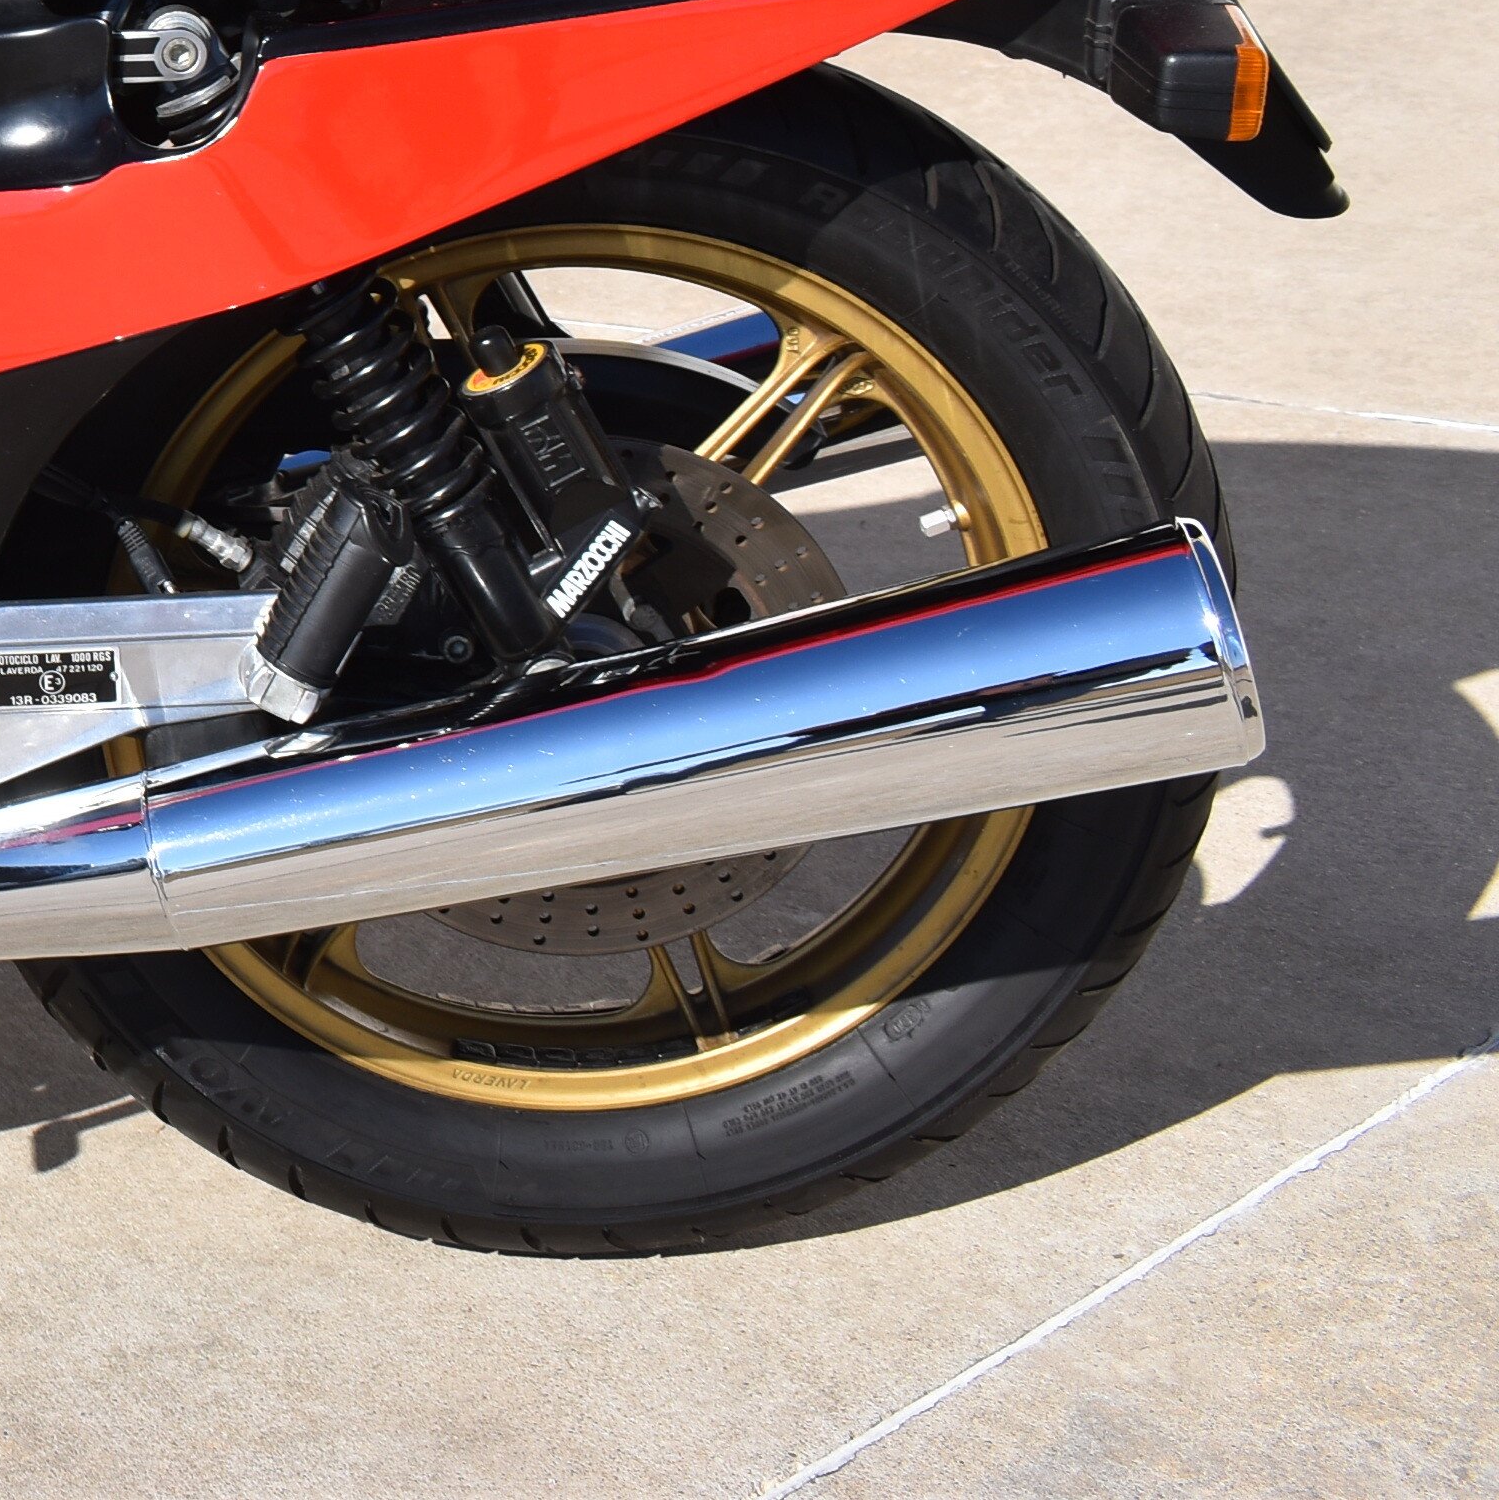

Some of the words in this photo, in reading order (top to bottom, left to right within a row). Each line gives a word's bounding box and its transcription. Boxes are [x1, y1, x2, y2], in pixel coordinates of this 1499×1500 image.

[546, 520, 632, 619] MARZOCCHI
[70, 652, 91, 663] 1000
[92, 651, 112, 662] RGS
[0, 666, 44, 676] LAVERDA
[451, 1067, 532, 1090] LAVERDA
